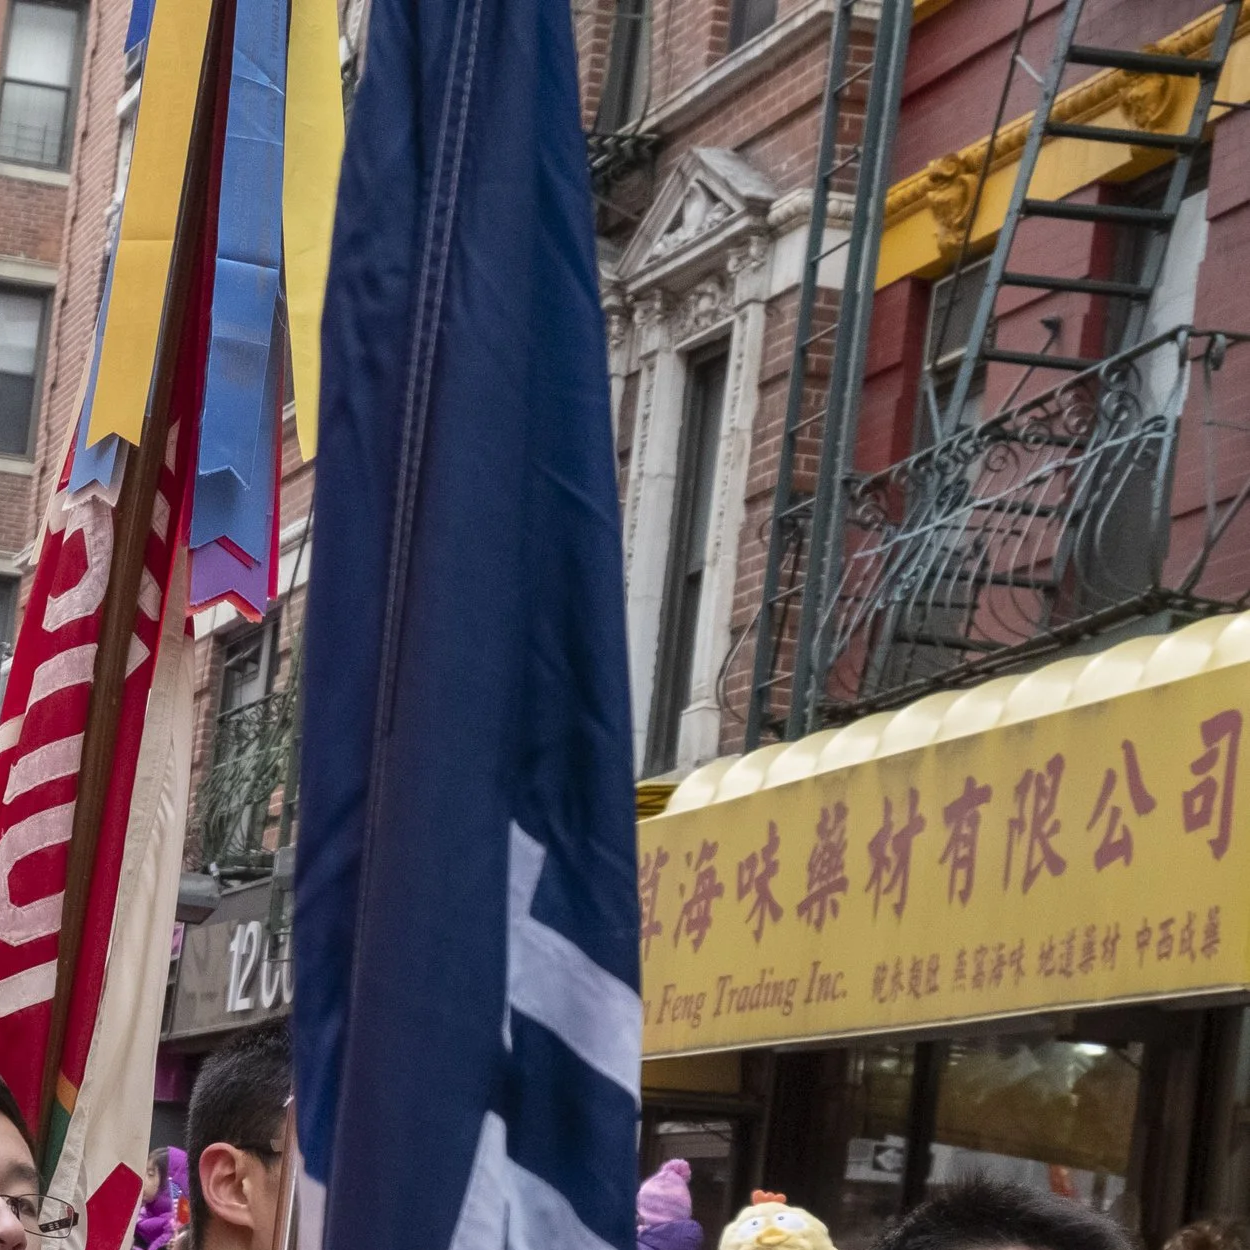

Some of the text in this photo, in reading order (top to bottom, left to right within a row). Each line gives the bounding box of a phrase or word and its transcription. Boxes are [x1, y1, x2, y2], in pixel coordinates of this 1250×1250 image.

[655, 983, 707, 1029] Feng
[713, 967, 799, 1017] Trading
[804, 960, 848, 1004] Inc.
